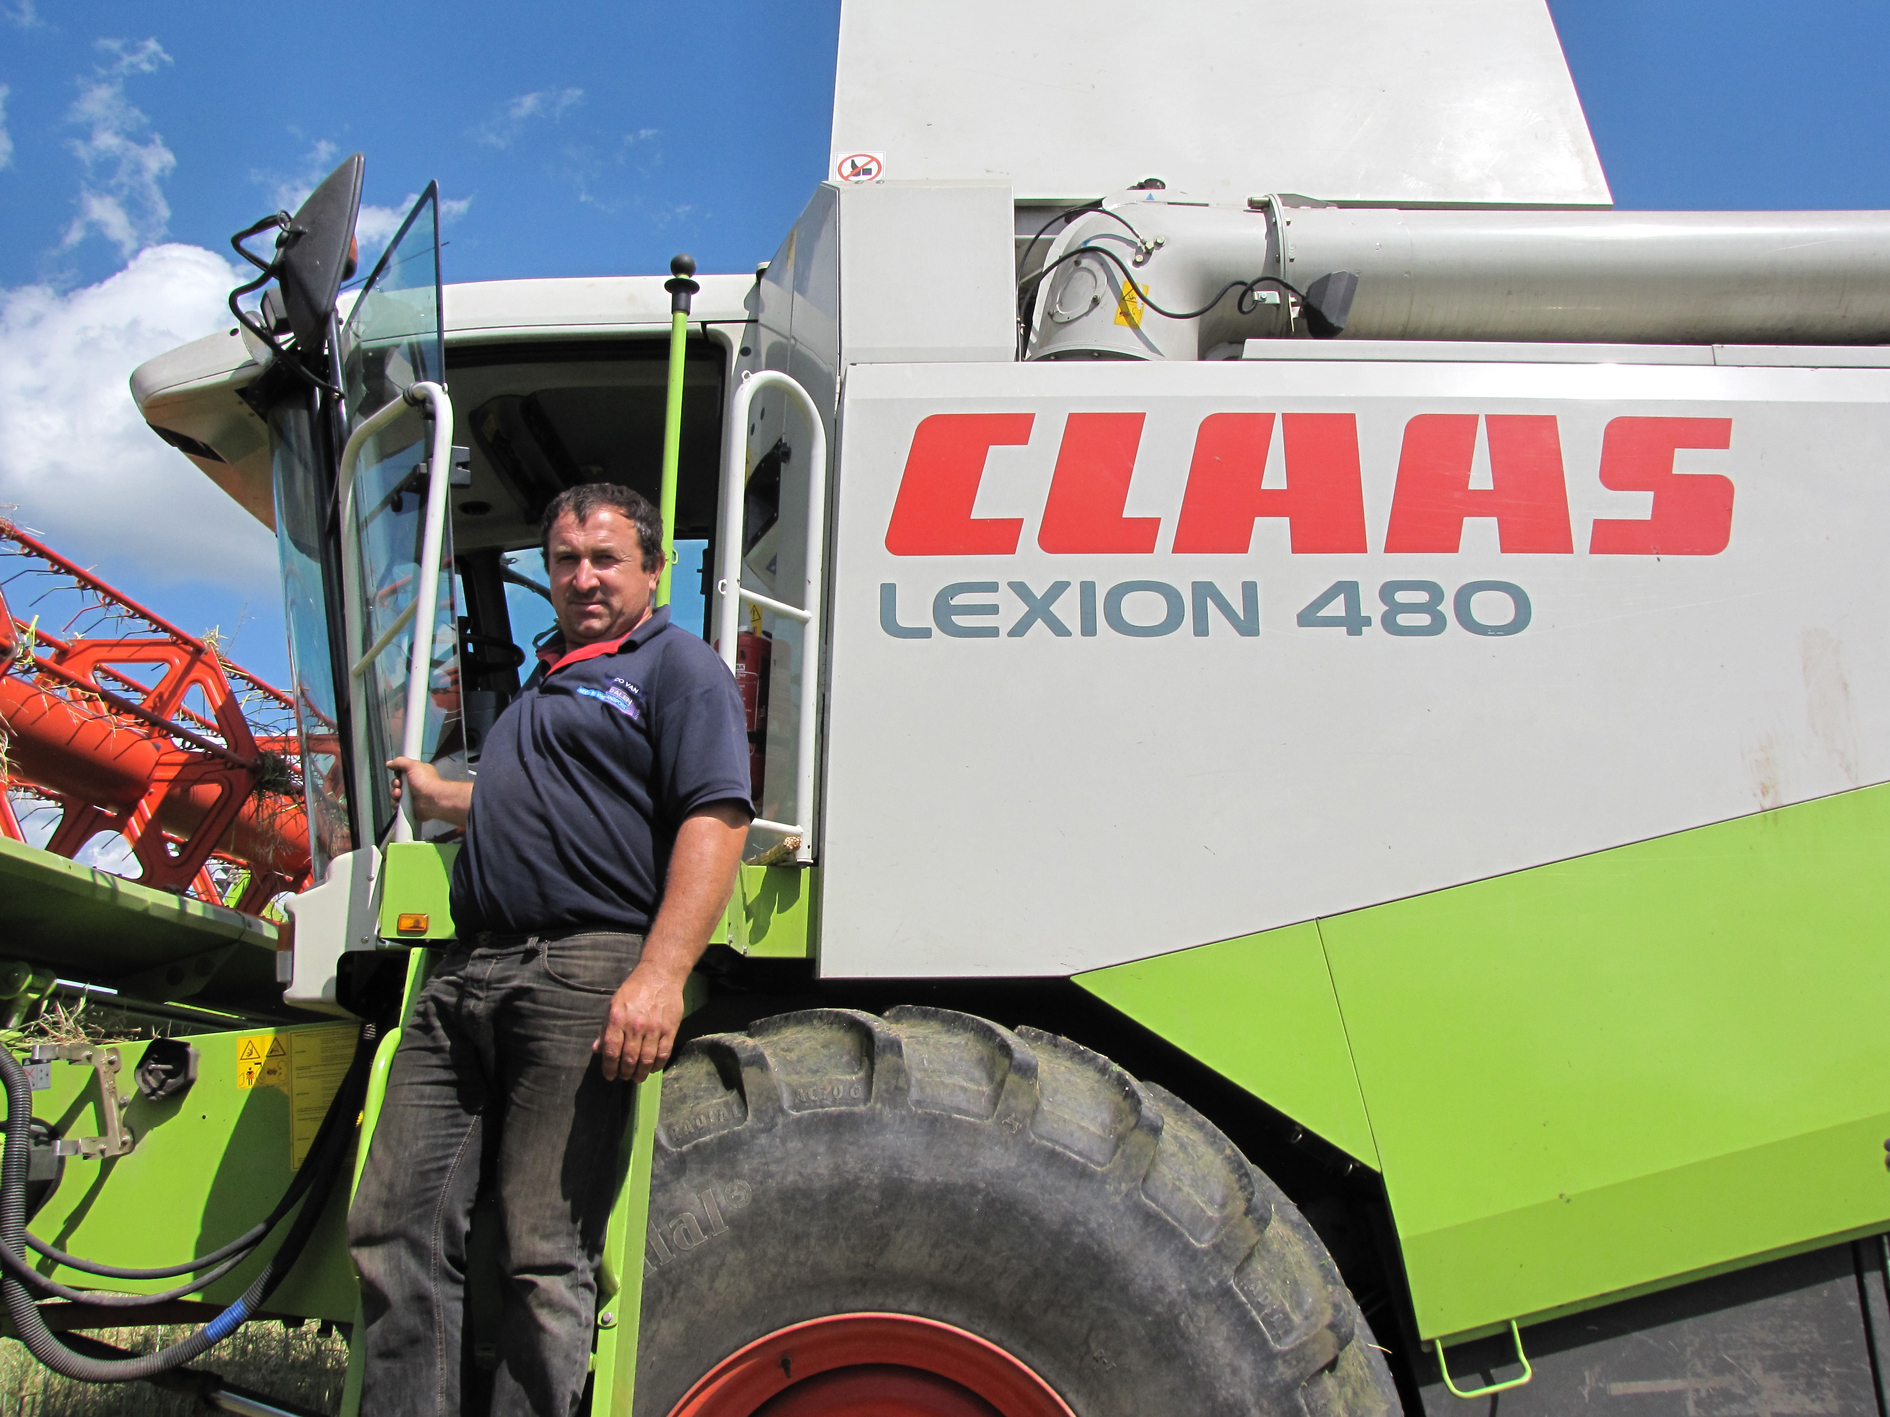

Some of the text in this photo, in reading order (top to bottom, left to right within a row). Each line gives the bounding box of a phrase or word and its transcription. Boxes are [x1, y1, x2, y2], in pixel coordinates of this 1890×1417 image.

[884, 411, 1735, 557] CLAAS
[879, 578, 1533, 639] LEXION 480
[625, 681, 640, 694] VAN
